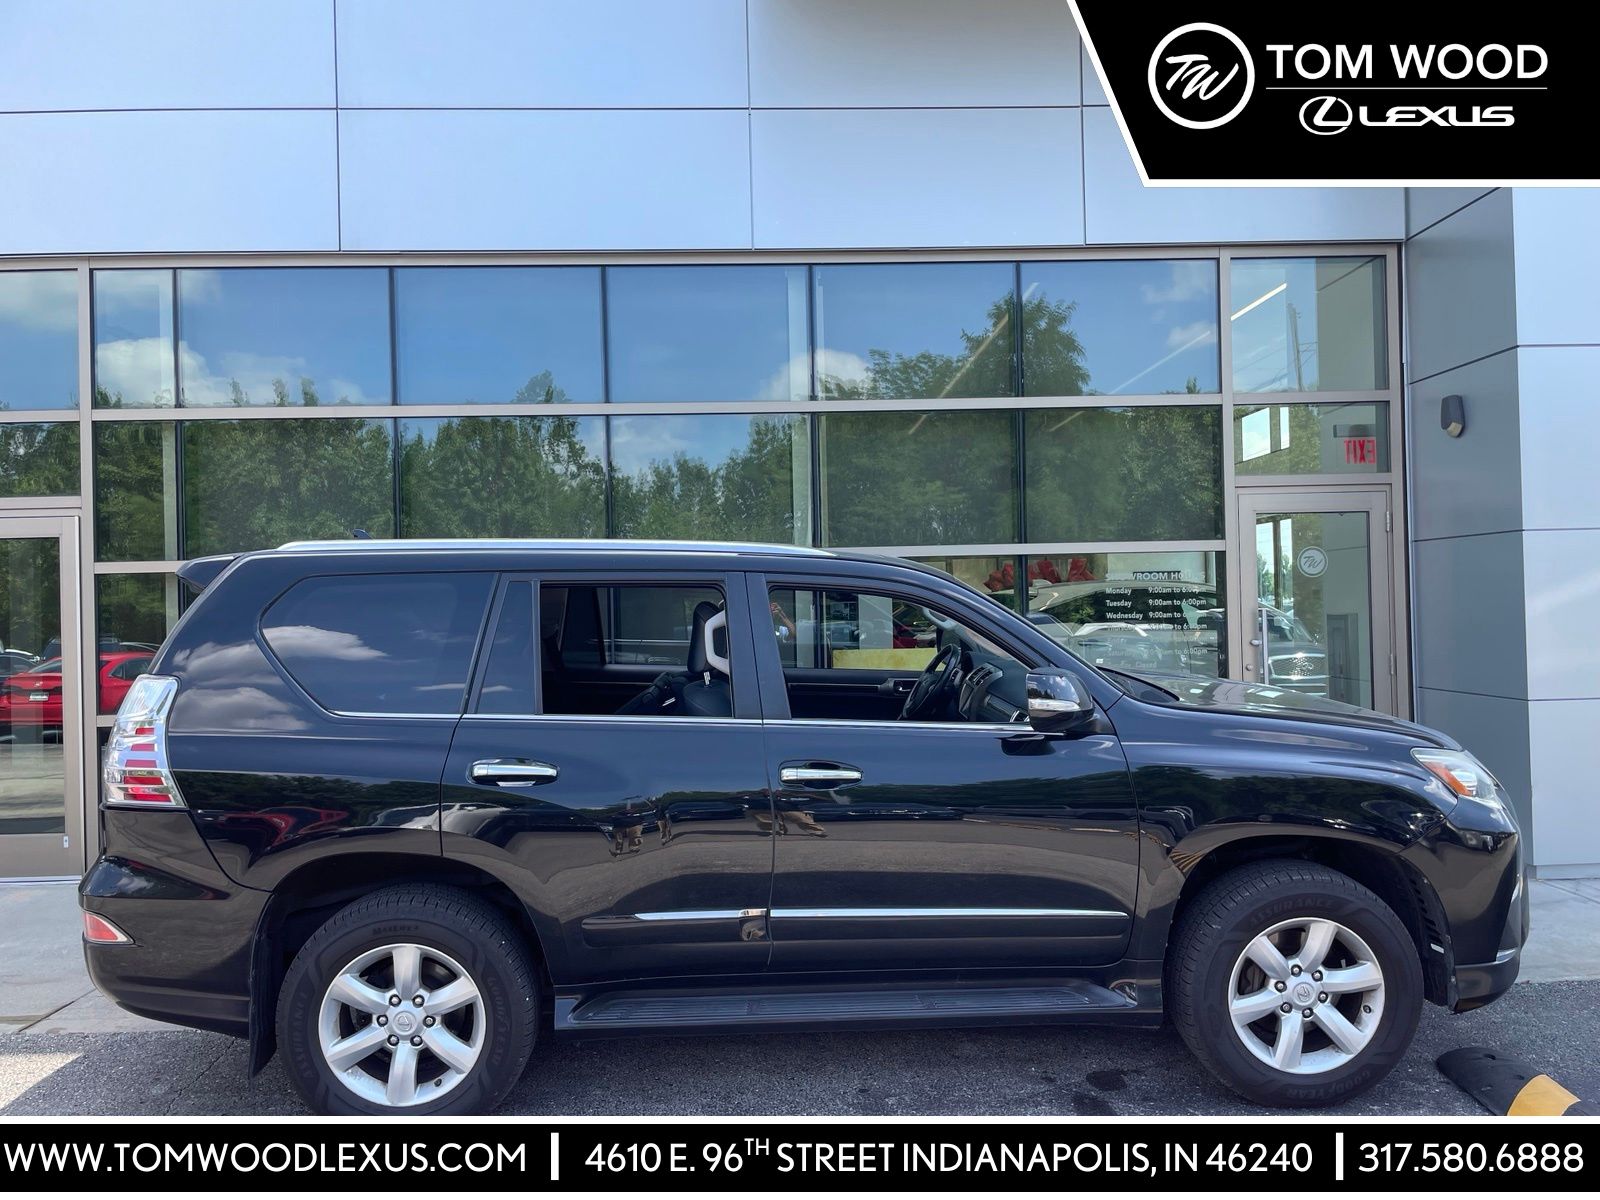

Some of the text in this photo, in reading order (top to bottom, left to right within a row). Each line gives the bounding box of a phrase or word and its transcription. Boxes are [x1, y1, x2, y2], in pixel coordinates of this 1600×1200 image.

[1105, 587, 1132, 596] Monday
[1105, 600, 1132, 608] Tuesday
[1182, 598, 1207, 606] 6:00pm
[1106, 612, 1144, 620] Wednesday
[1183, 623, 1208, 631] 6:pm
